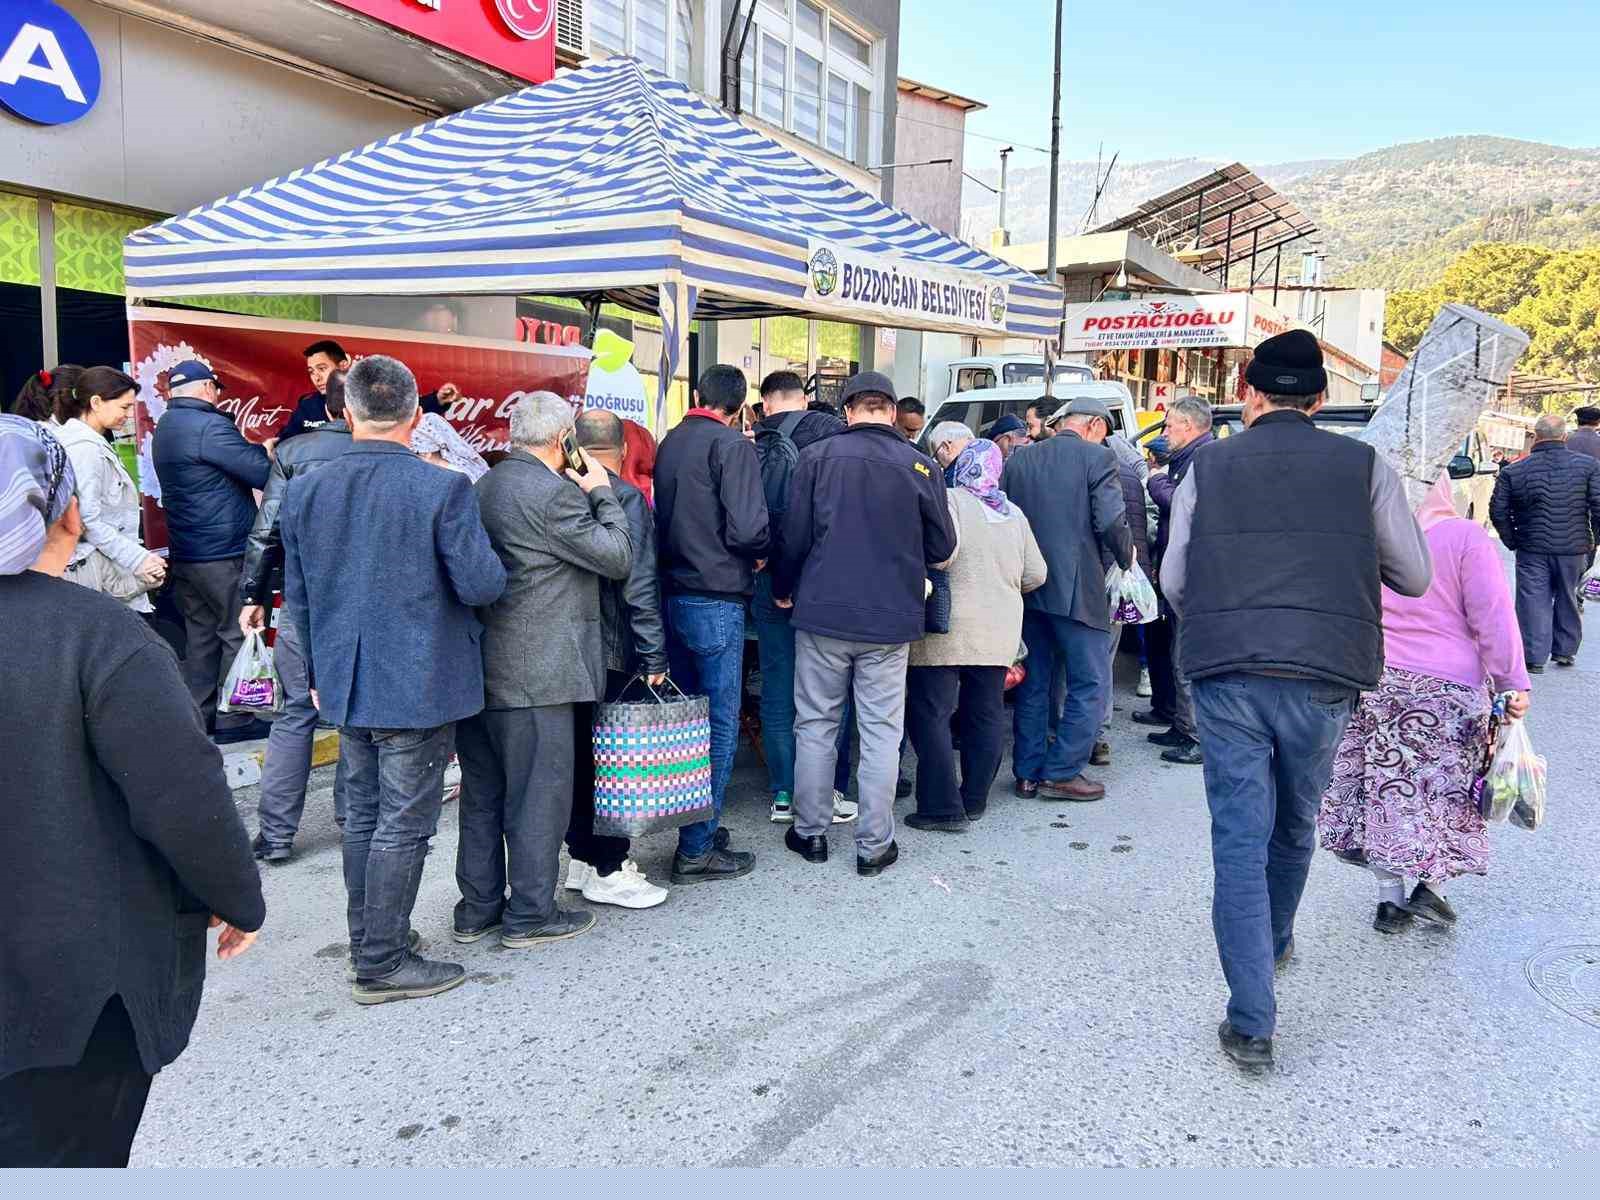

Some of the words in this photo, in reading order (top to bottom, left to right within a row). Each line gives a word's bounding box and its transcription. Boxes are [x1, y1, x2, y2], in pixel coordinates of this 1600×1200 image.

[0, 22, 87, 105] A
[841, 263, 918, 309] BOZDOĞAN
[921, 279, 987, 321] BELEDİYESİ
[1082, 309, 1235, 332] POSTACIOĞLU
[216, 396, 294, 438] Mart
[586, 393, 645, 413] DOĞRUSU
